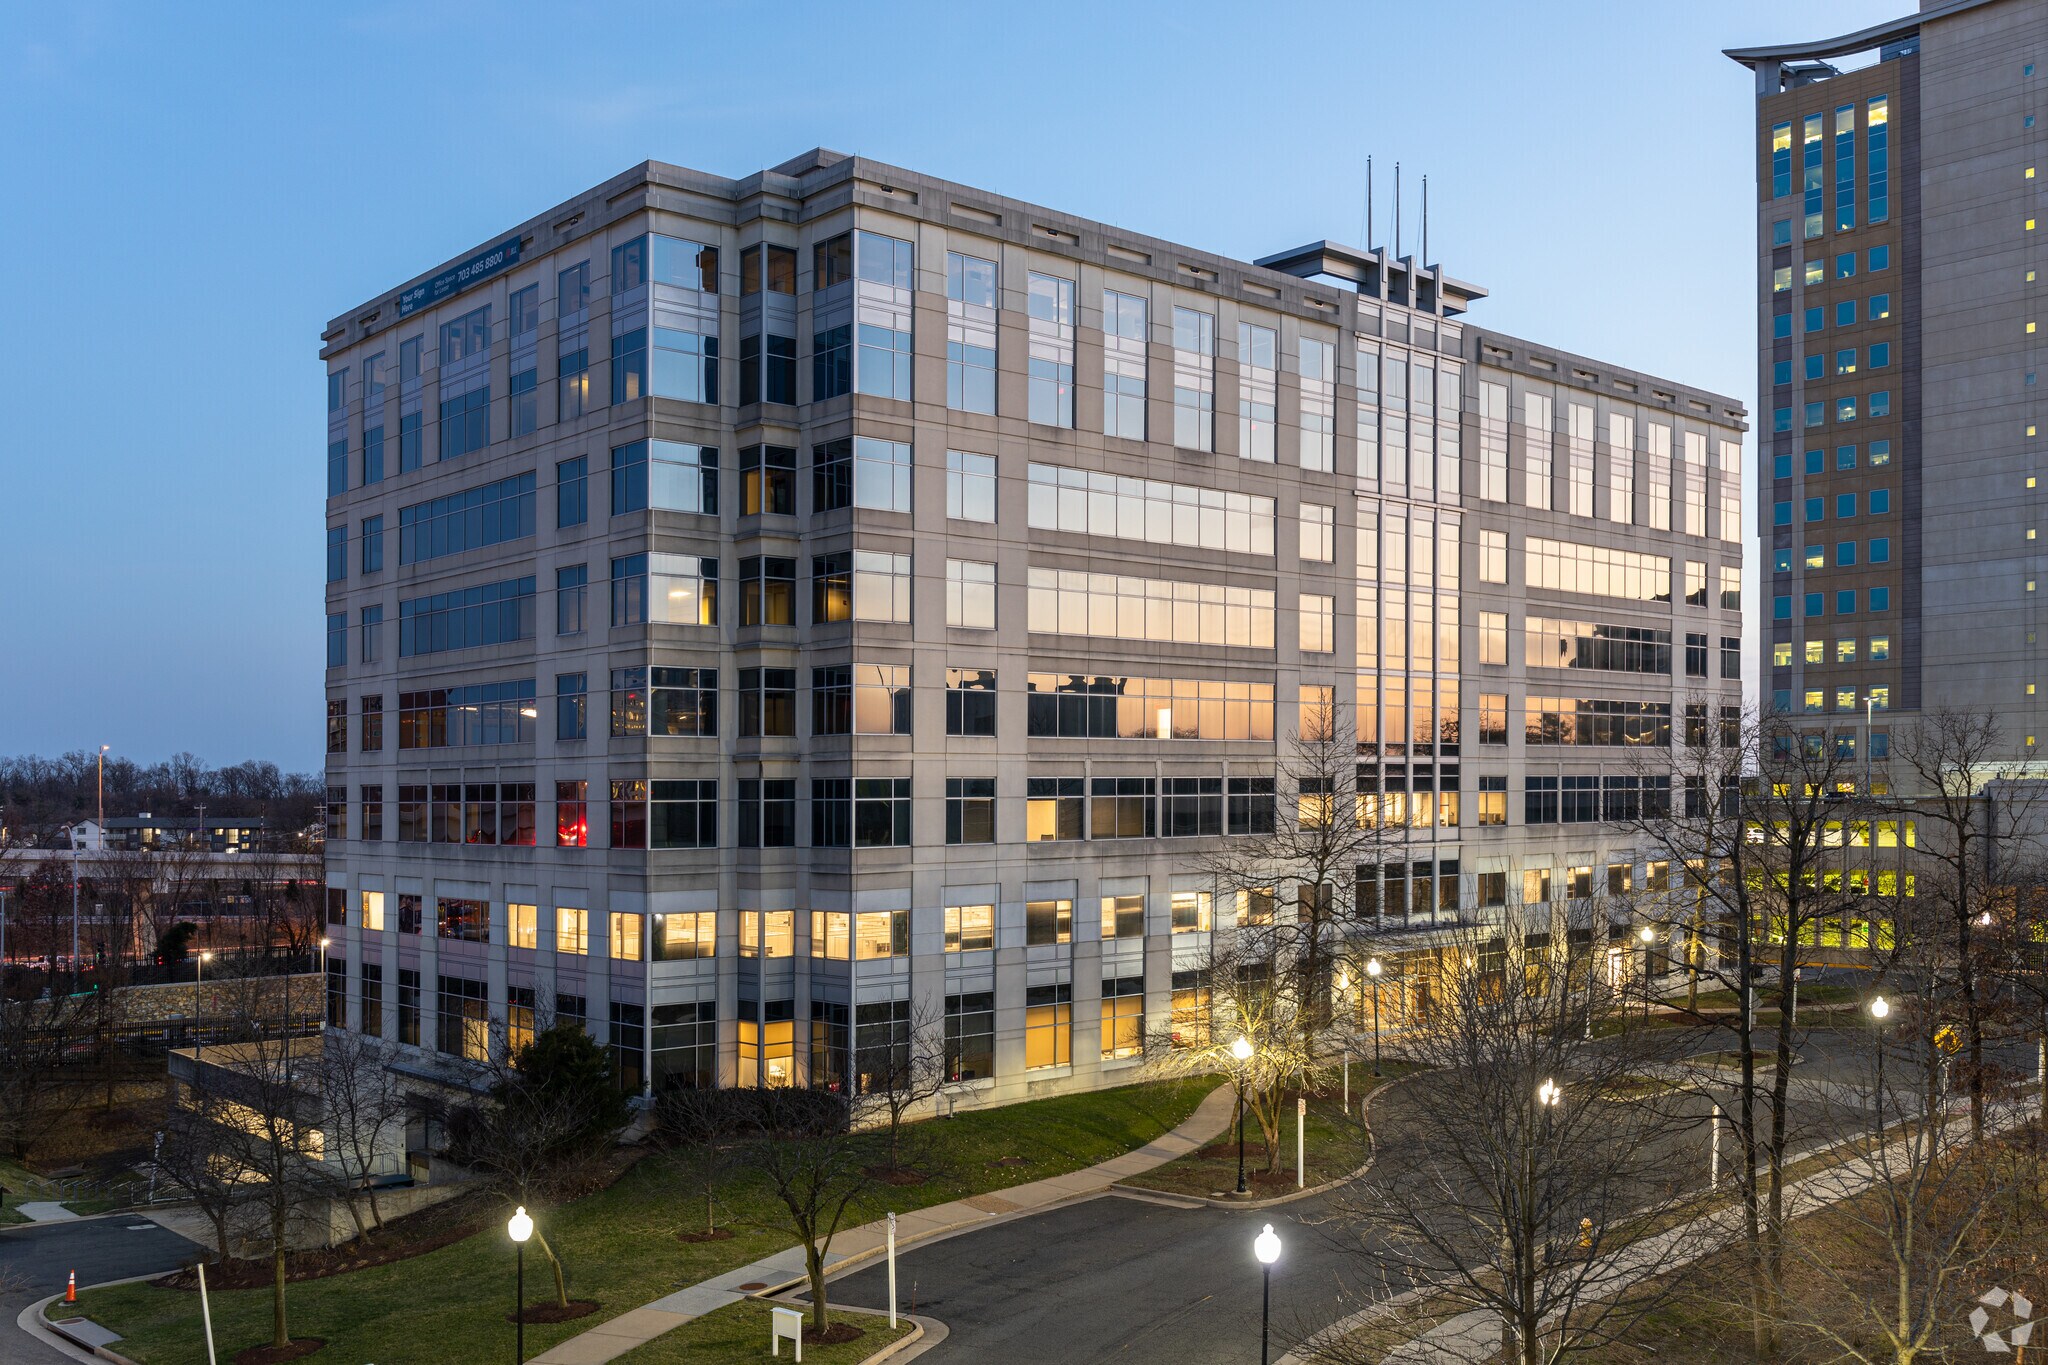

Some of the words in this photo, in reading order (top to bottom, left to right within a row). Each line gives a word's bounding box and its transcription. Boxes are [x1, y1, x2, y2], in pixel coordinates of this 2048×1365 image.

[457, 267, 470, 283] 703
[470, 261, 484, 276] 485
[484, 251, 503, 269] 8800
[402, 293, 414, 304] Your
[413, 288, 425, 299] Sign
